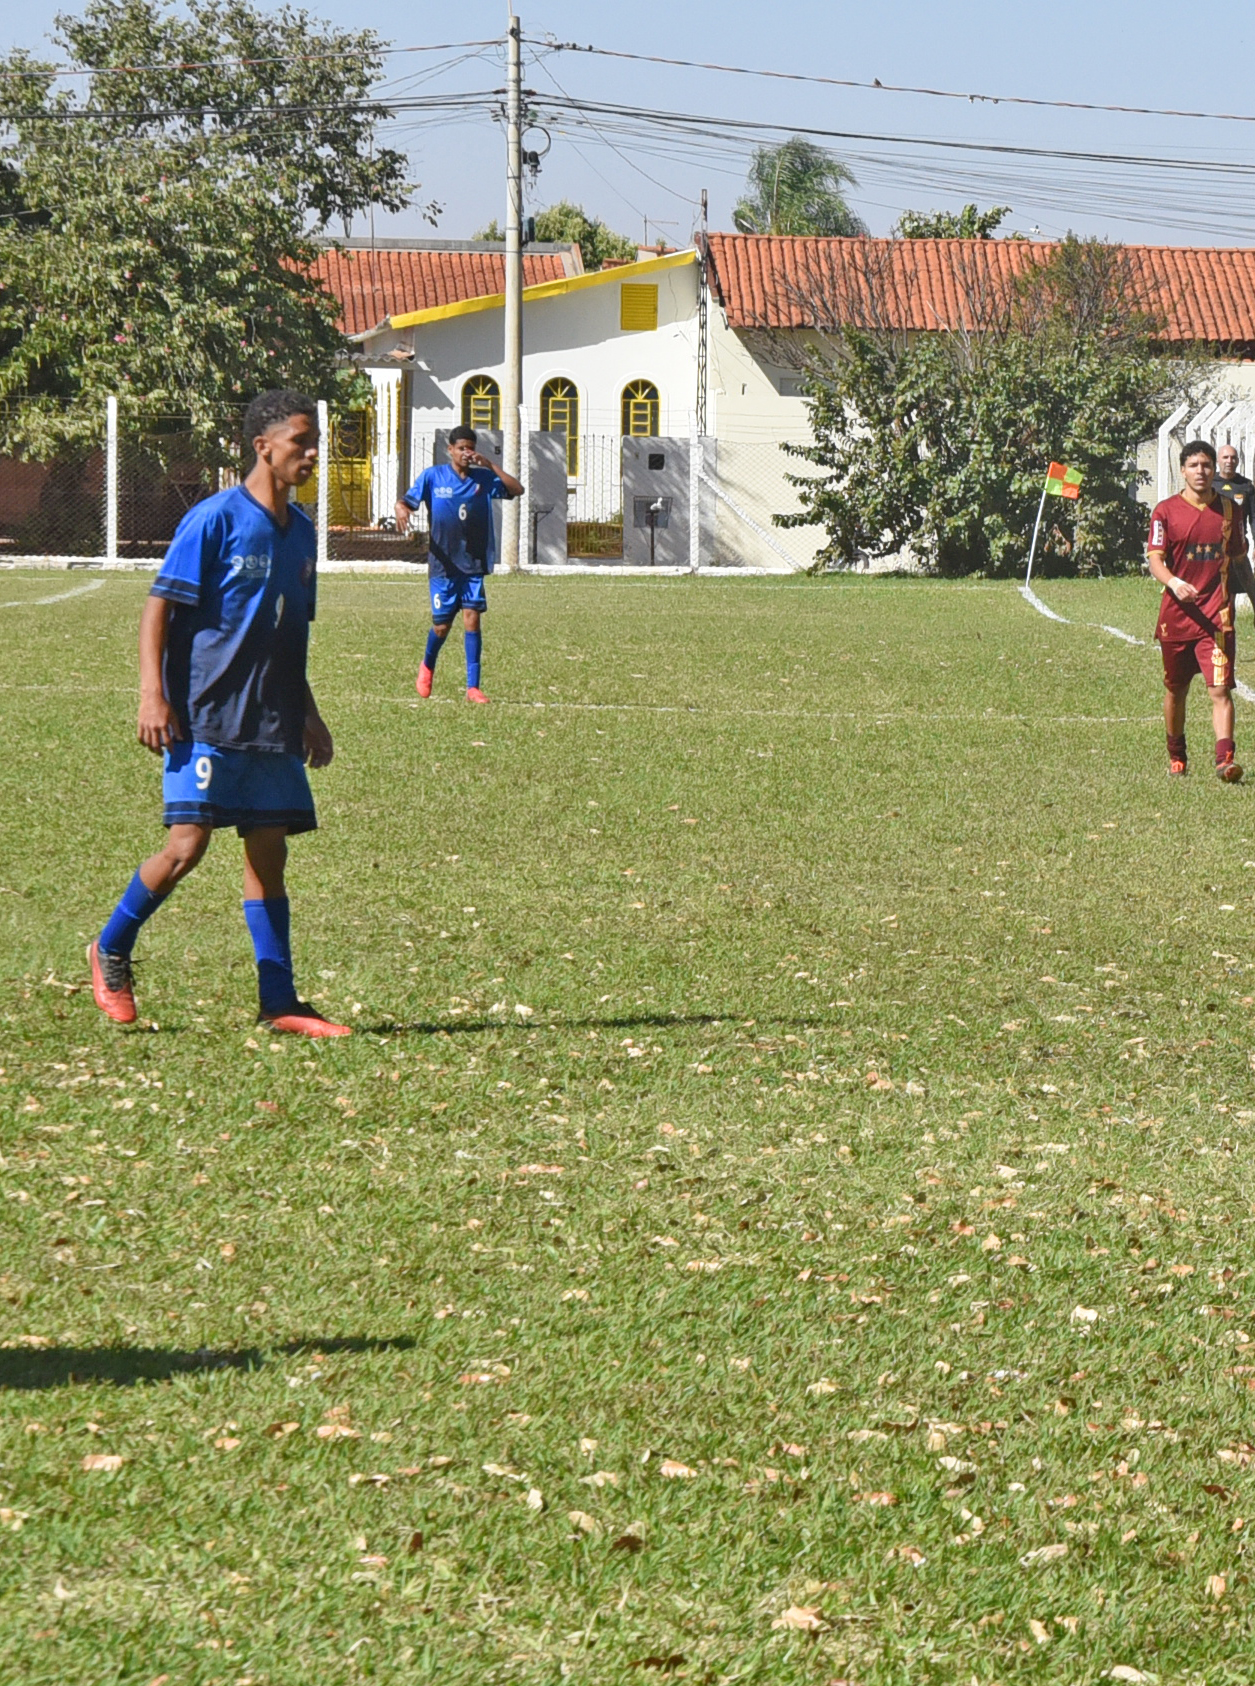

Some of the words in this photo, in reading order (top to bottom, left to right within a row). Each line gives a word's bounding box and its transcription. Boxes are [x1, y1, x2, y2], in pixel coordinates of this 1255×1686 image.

[458, 503, 467, 521] 6
[433, 593, 441, 609] 6
[195, 756, 212, 790] 9
